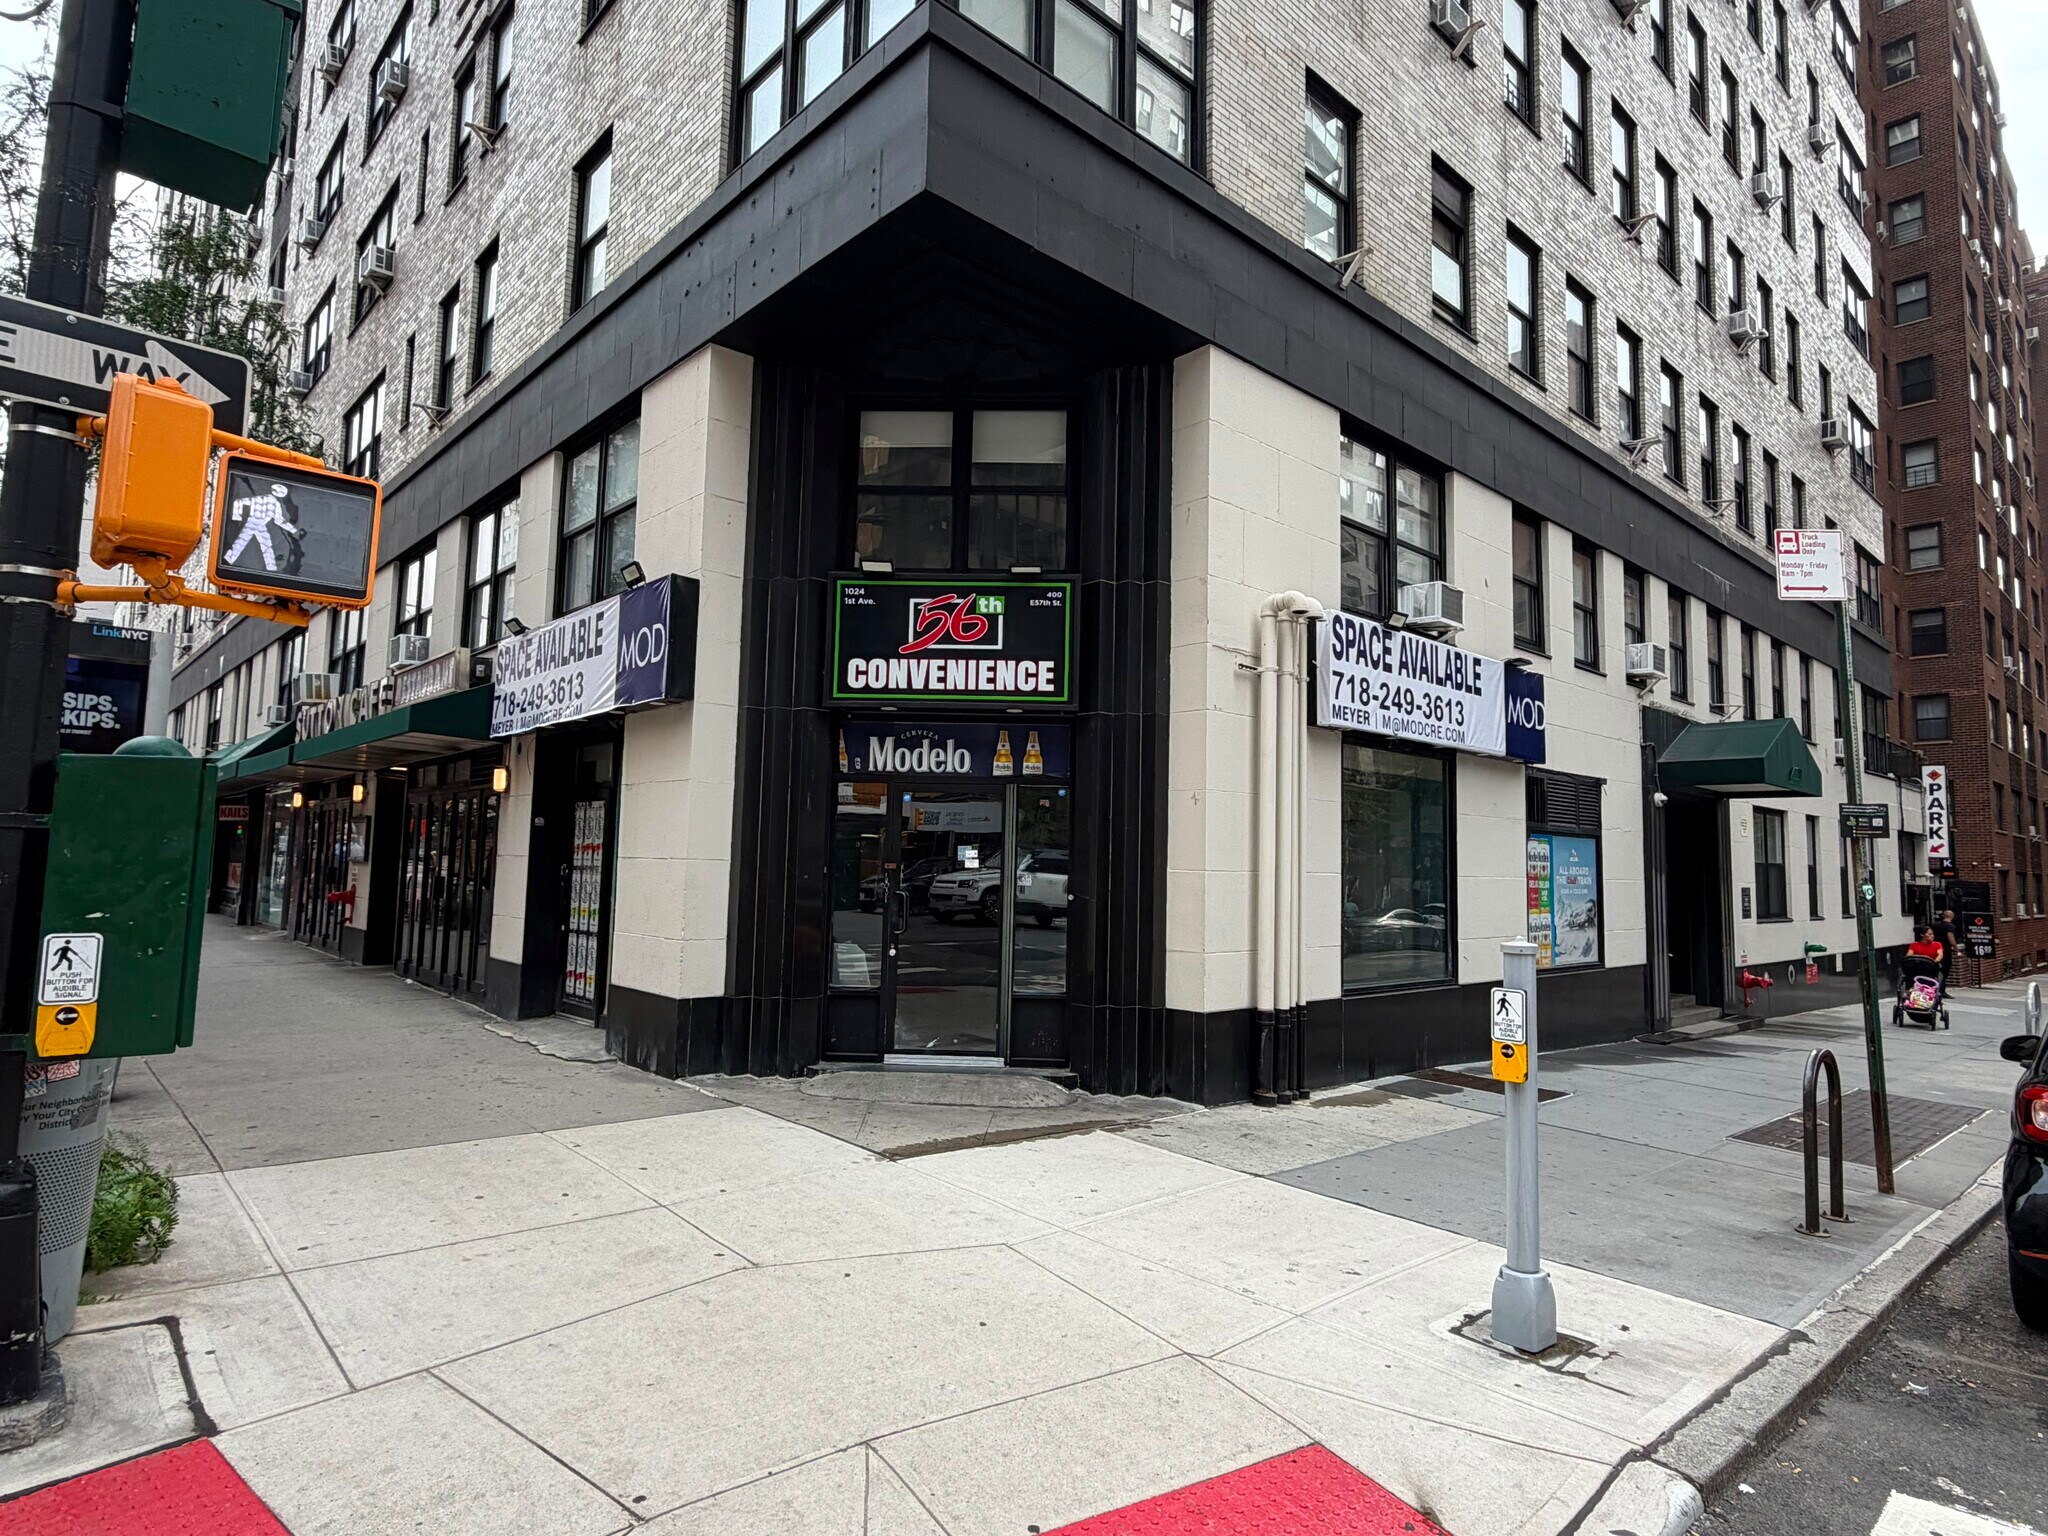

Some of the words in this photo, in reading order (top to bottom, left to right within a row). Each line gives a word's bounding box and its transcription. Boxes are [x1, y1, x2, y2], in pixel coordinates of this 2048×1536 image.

[1801, 541, 1826, 549] Loading
[1801, 548, 1816, 556] Only
[1780, 561, 1804, 570] Monday
[1809, 561, 1828, 570] Friday
[1800, 570, 1814, 578] 7pm
[844, 587, 865, 596] 1024
[844, 597, 856, 605] 1st
[857, 597, 876, 605] Ave.
[92, 625, 149, 641] LinkNYC
[495, 637, 533, 687] SPACE
[533, 611, 605, 676] AVAILABLE
[618, 623, 666, 673] MOD
[1331, 614, 1394, 674] SPACE
[1398, 635, 1483, 697] AVAILABLE
[846, 657, 1055, 692] CONVENIENCE
[350, 675, 393, 728] CAFE
[494, 671, 584, 720] 718-249-3613
[1332, 670, 1465, 727] 718-249-3613
[61, 709, 121, 730] KIPS.
[1507, 693, 1545, 731] MOD
[491, 719, 514, 735] MEYER
[1332, 703, 1371, 726] MEYER
[1382, 715, 1466, 745] M@MODCRE.COM
[900, 729, 939, 741] CERVEZA
[868, 736, 973, 774] Modelo
[220, 807, 249, 819] NAILS
[1927, 783, 1946, 840] PARK
[46, 978, 77, 986] BUTTON
[78, 977, 94, 985] FOR
[52, 984, 87, 992] AUDIBLE
[54, 991, 83, 999] SIGNAL
[33, 1111, 56, 1121] Your
[58, 1107, 76, 1118] City
[39, 1117, 72, 1131] District
